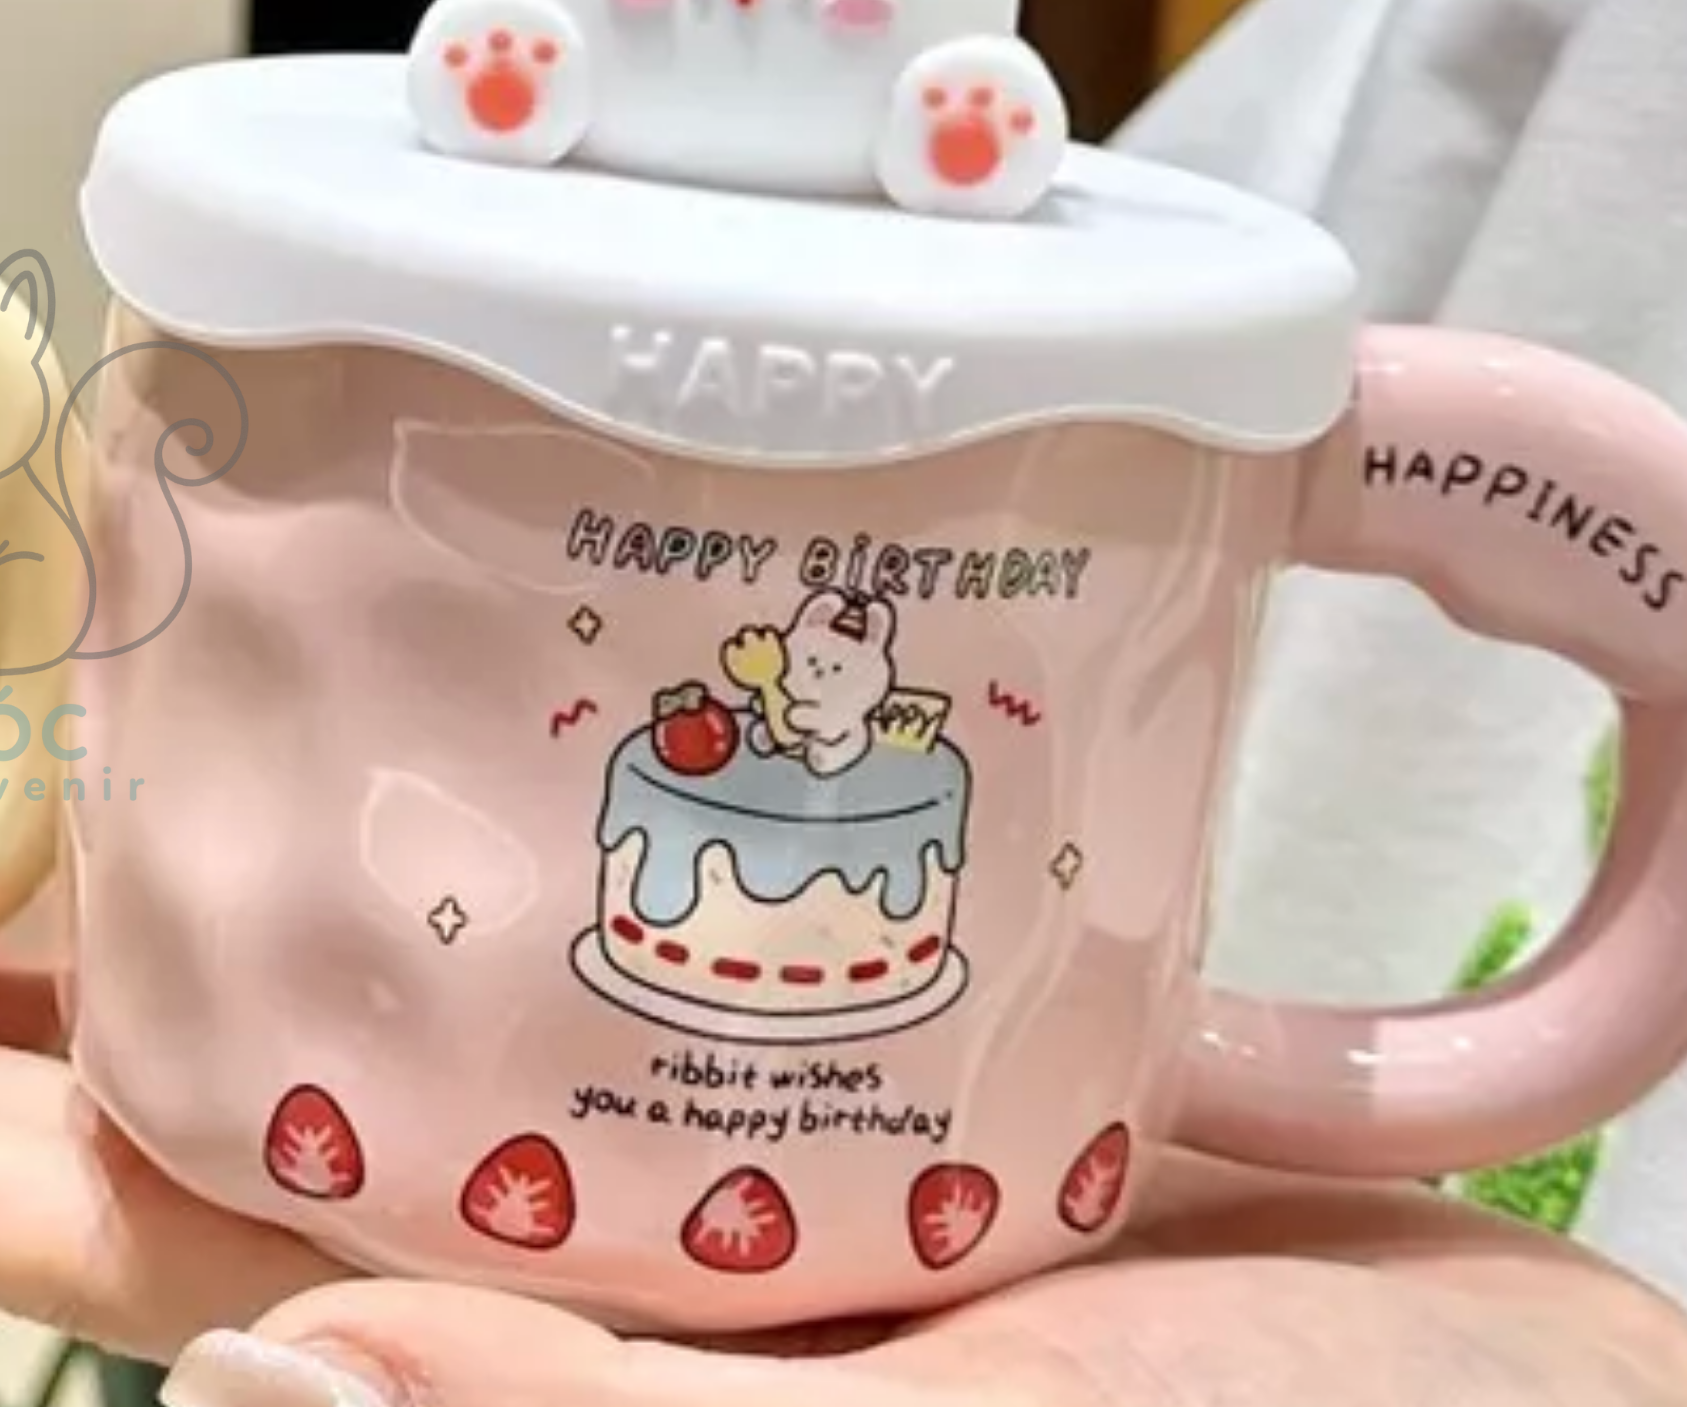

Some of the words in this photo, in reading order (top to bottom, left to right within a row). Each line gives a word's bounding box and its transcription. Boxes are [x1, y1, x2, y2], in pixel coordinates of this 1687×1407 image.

[612, 324, 958, 426] HAPPY
[566, 508, 778, 583] HAPPY
[1364, 446, 1685, 611] HAPPINESS
[650, 1051, 759, 1089] ribbit
[570, 1088, 636, 1119] you
[647, 1103, 670, 1124] a
[683, 1100, 789, 1142] happy
[799, 1099, 952, 1144] birthday
